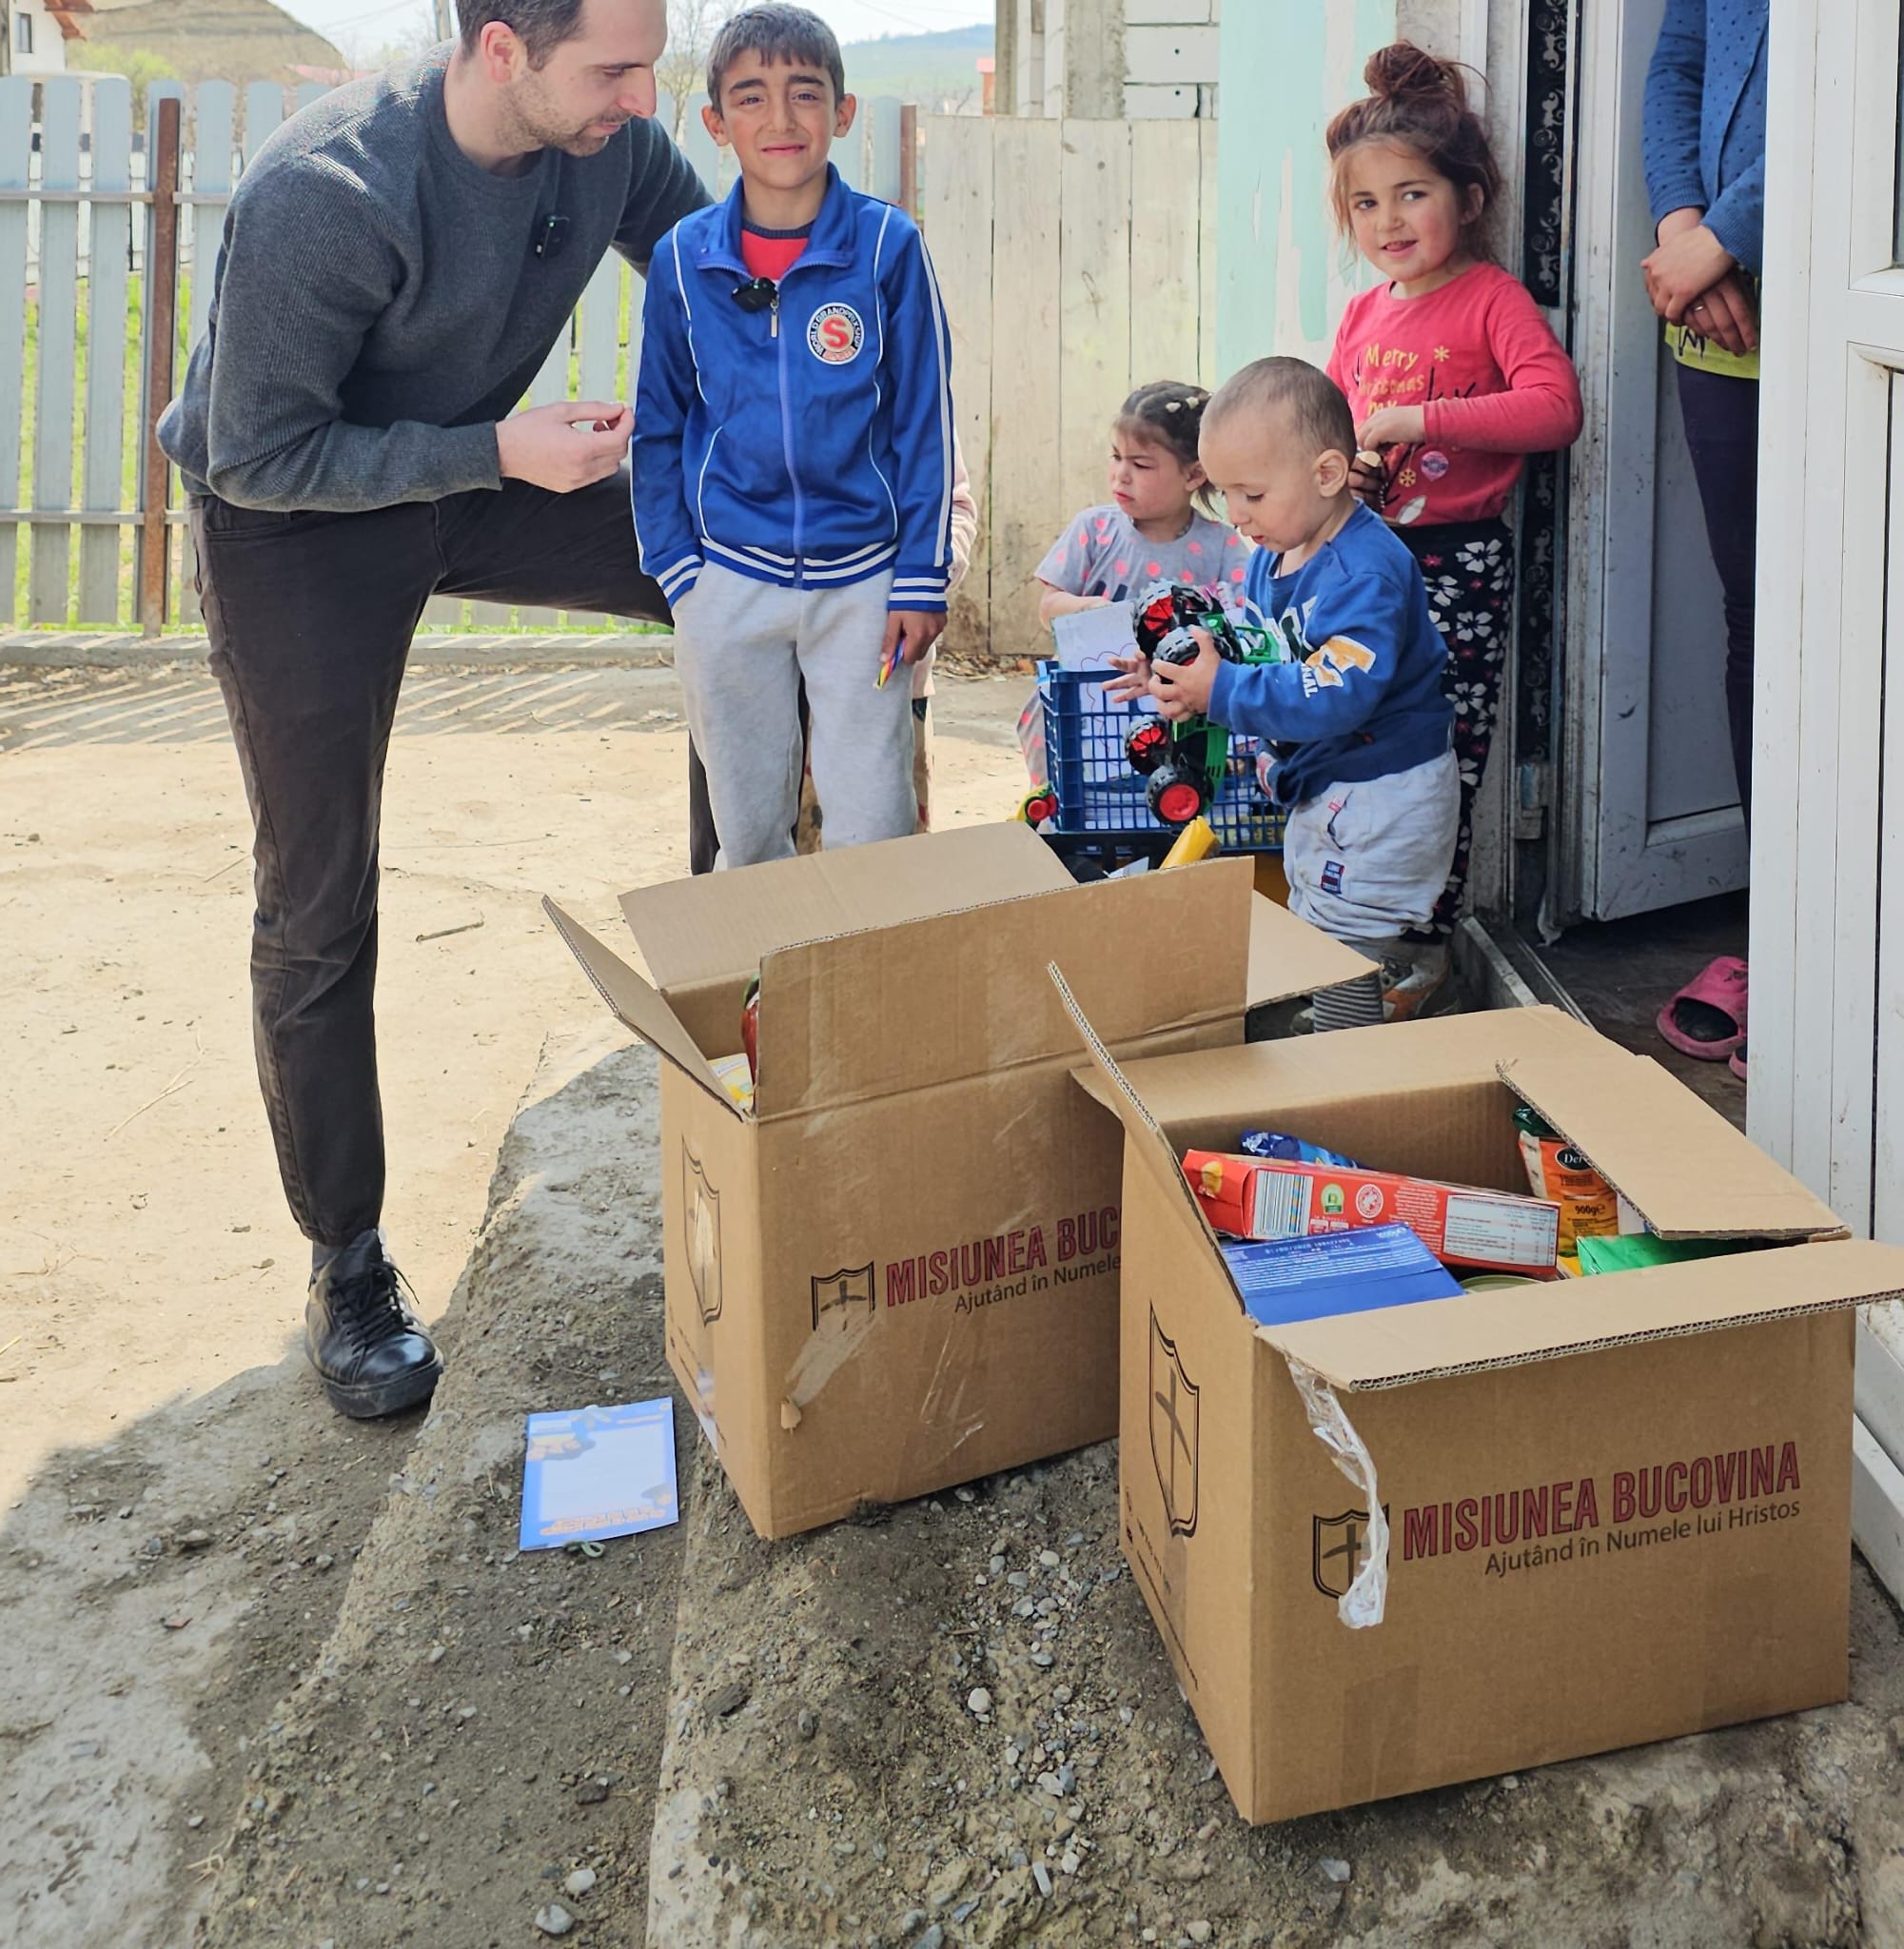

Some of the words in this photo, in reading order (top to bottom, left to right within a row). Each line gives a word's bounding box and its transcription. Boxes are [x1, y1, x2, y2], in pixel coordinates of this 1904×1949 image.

[822, 317, 850, 349] S
[1365, 343, 1420, 372] Merry
[885, 1225, 1048, 1308] MISIUNEA
[954, 1275, 1028, 1314] Ajutând
[1031, 1273, 1049, 1292] în
[1053, 1254, 1121, 1286] Numele
[1403, 1478, 1600, 1562] MISIUNEA
[1612, 1441, 1801, 1524] BUCOVINA
[1484, 1539, 1574, 1578] Ajutând
[1579, 1536, 1600, 1559] în
[1605, 1521, 1692, 1553] Numele
[1696, 1511, 1723, 1535] lui
[1727, 1500, 1801, 1532] Hristos
